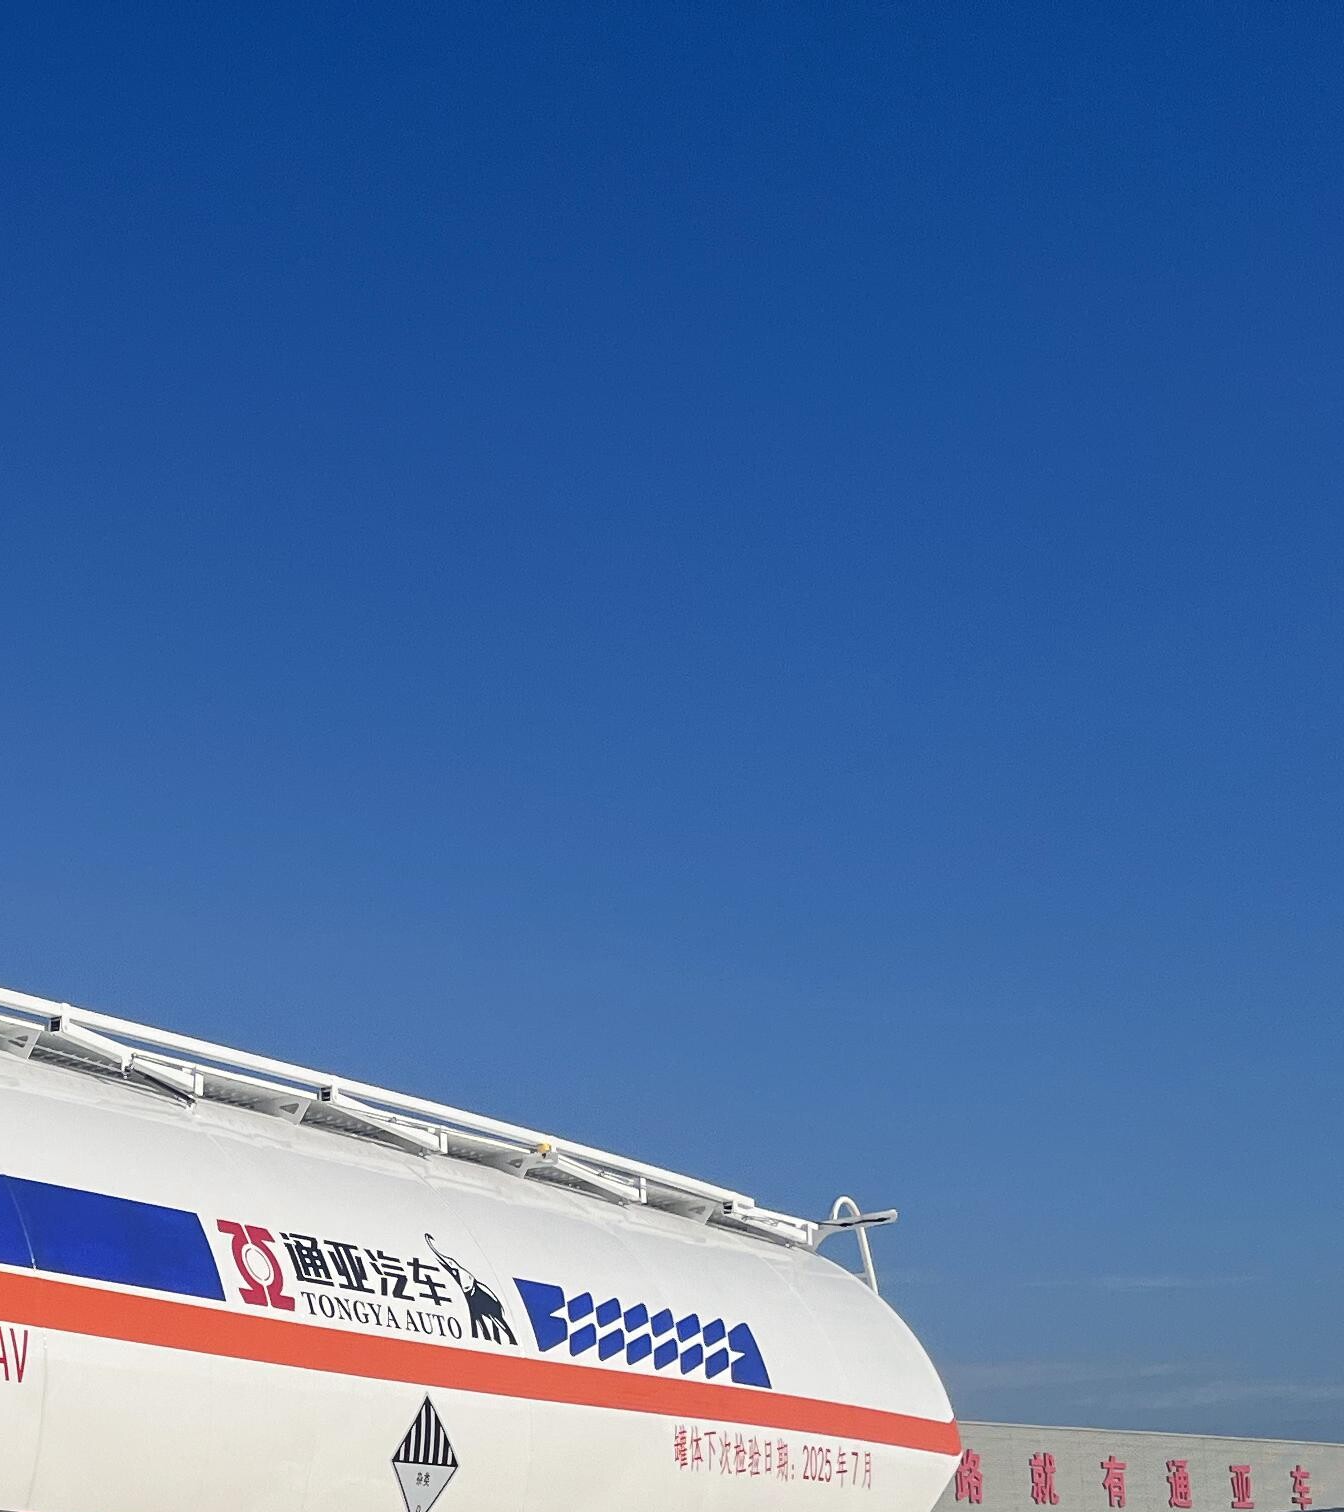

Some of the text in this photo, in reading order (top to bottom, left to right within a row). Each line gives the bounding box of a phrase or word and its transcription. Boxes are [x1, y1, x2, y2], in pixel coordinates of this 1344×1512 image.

[279, 1231, 453, 1306] 通亚汽车
[301, 1291, 462, 1339] TONGYA AUTO
